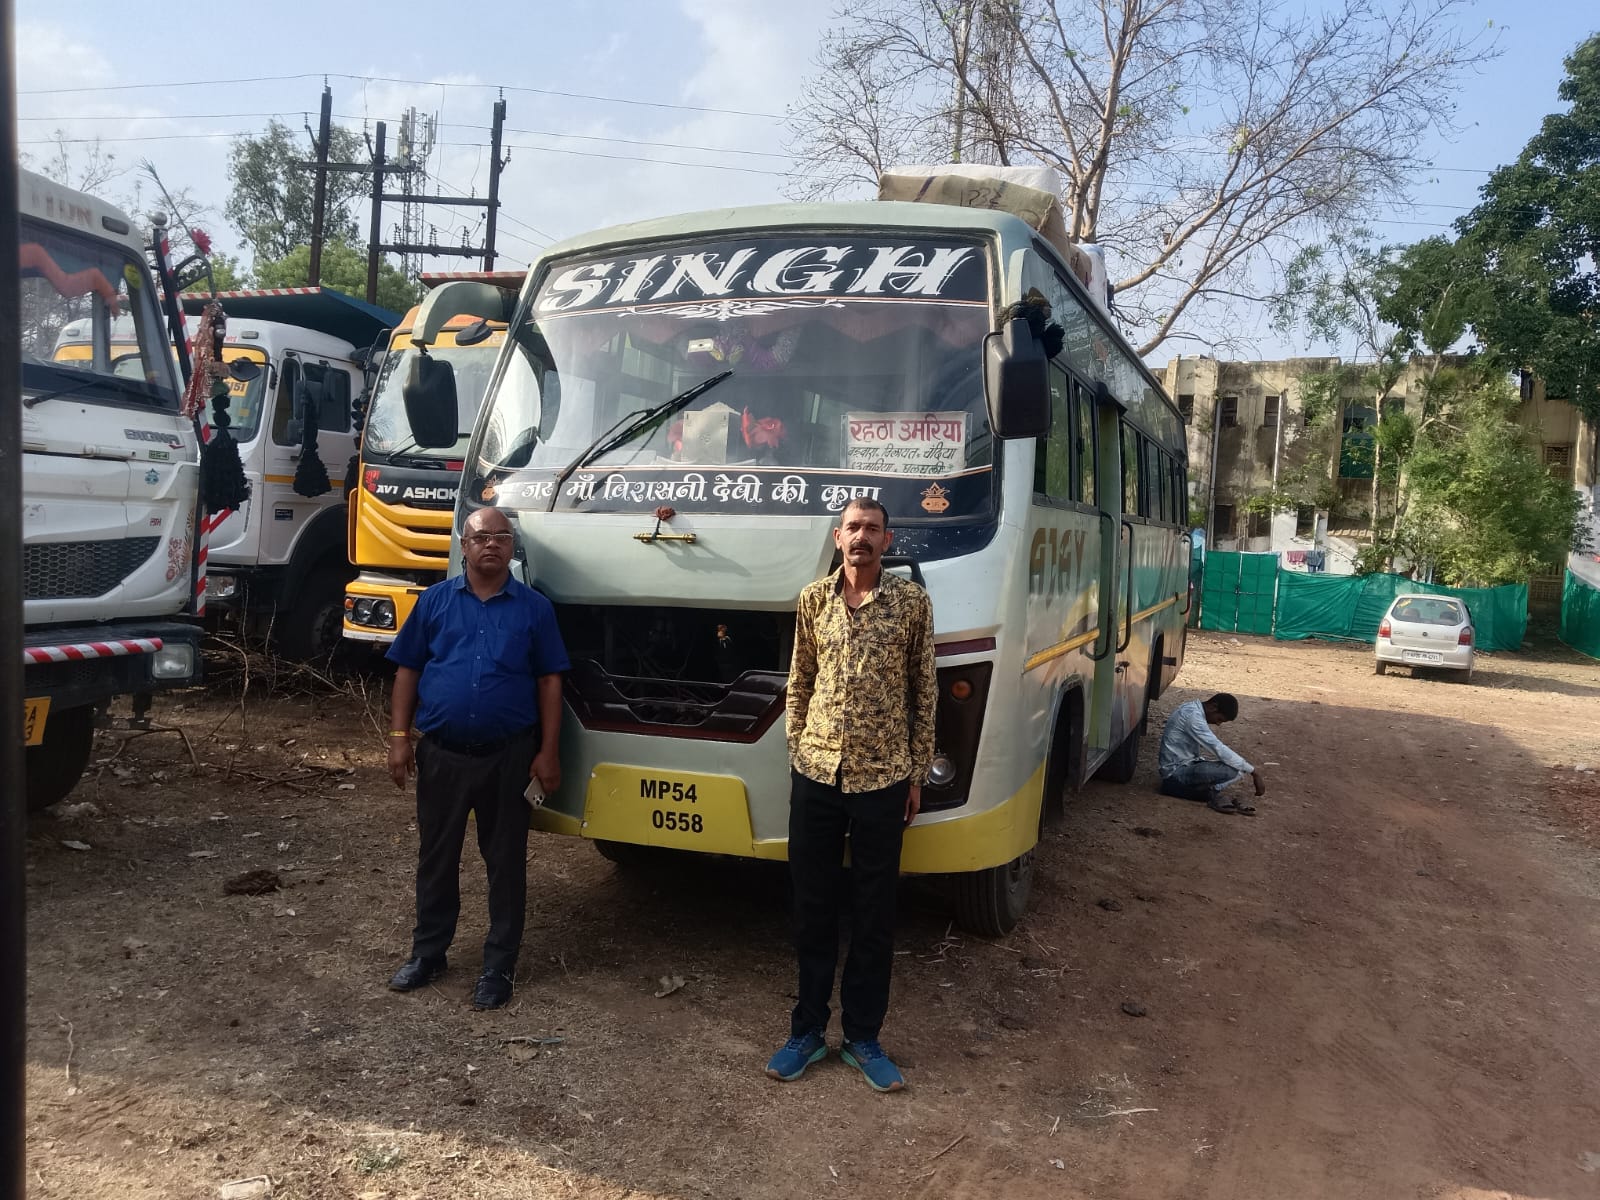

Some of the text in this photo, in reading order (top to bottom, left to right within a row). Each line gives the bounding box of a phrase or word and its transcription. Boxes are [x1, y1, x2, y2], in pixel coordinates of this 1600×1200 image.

[538, 245, 976, 312] SINGH
[898, 413, 962, 442] उमरिया
[567, 473, 598, 499] माँ
[602, 473, 708, 502] विरासनी
[712, 473, 764, 502] देवी
[771, 475, 809, 504] की
[640, 779, 697, 803] MP54
[652, 809, 703, 833] 0558
